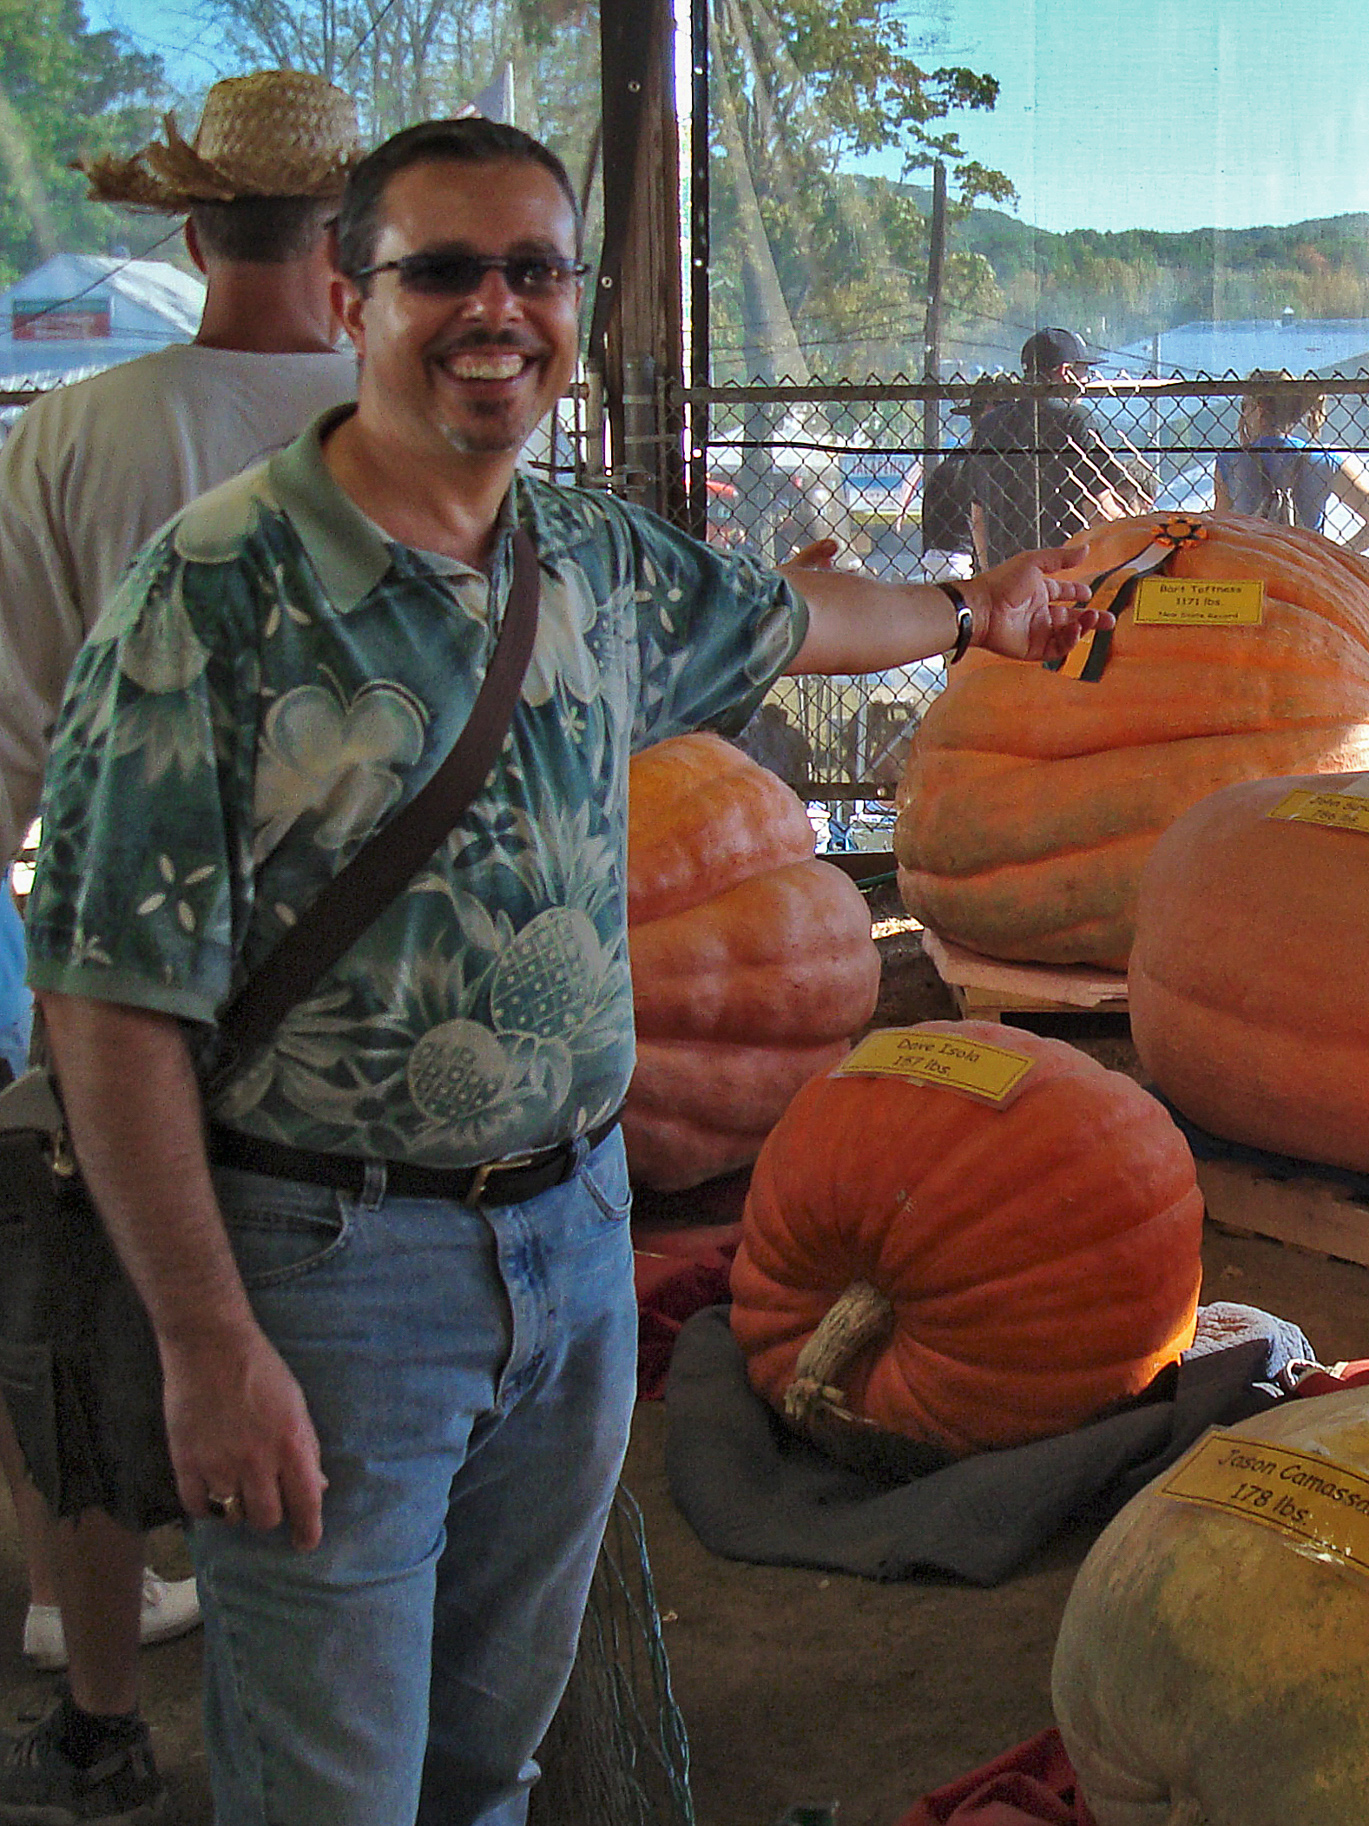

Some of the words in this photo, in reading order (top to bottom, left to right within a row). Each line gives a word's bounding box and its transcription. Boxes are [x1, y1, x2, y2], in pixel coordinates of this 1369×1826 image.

[1160, 584, 1185, 594] Bart
[1175, 597, 1200, 606] 1171
[897, 1037, 936, 1053] Dave
[938, 1042, 981, 1064] Isola
[1217, 1448, 1278, 1476] Jason
[1230, 1482, 1274, 1508] 178
[1273, 1493, 1308, 1526] lbs.
